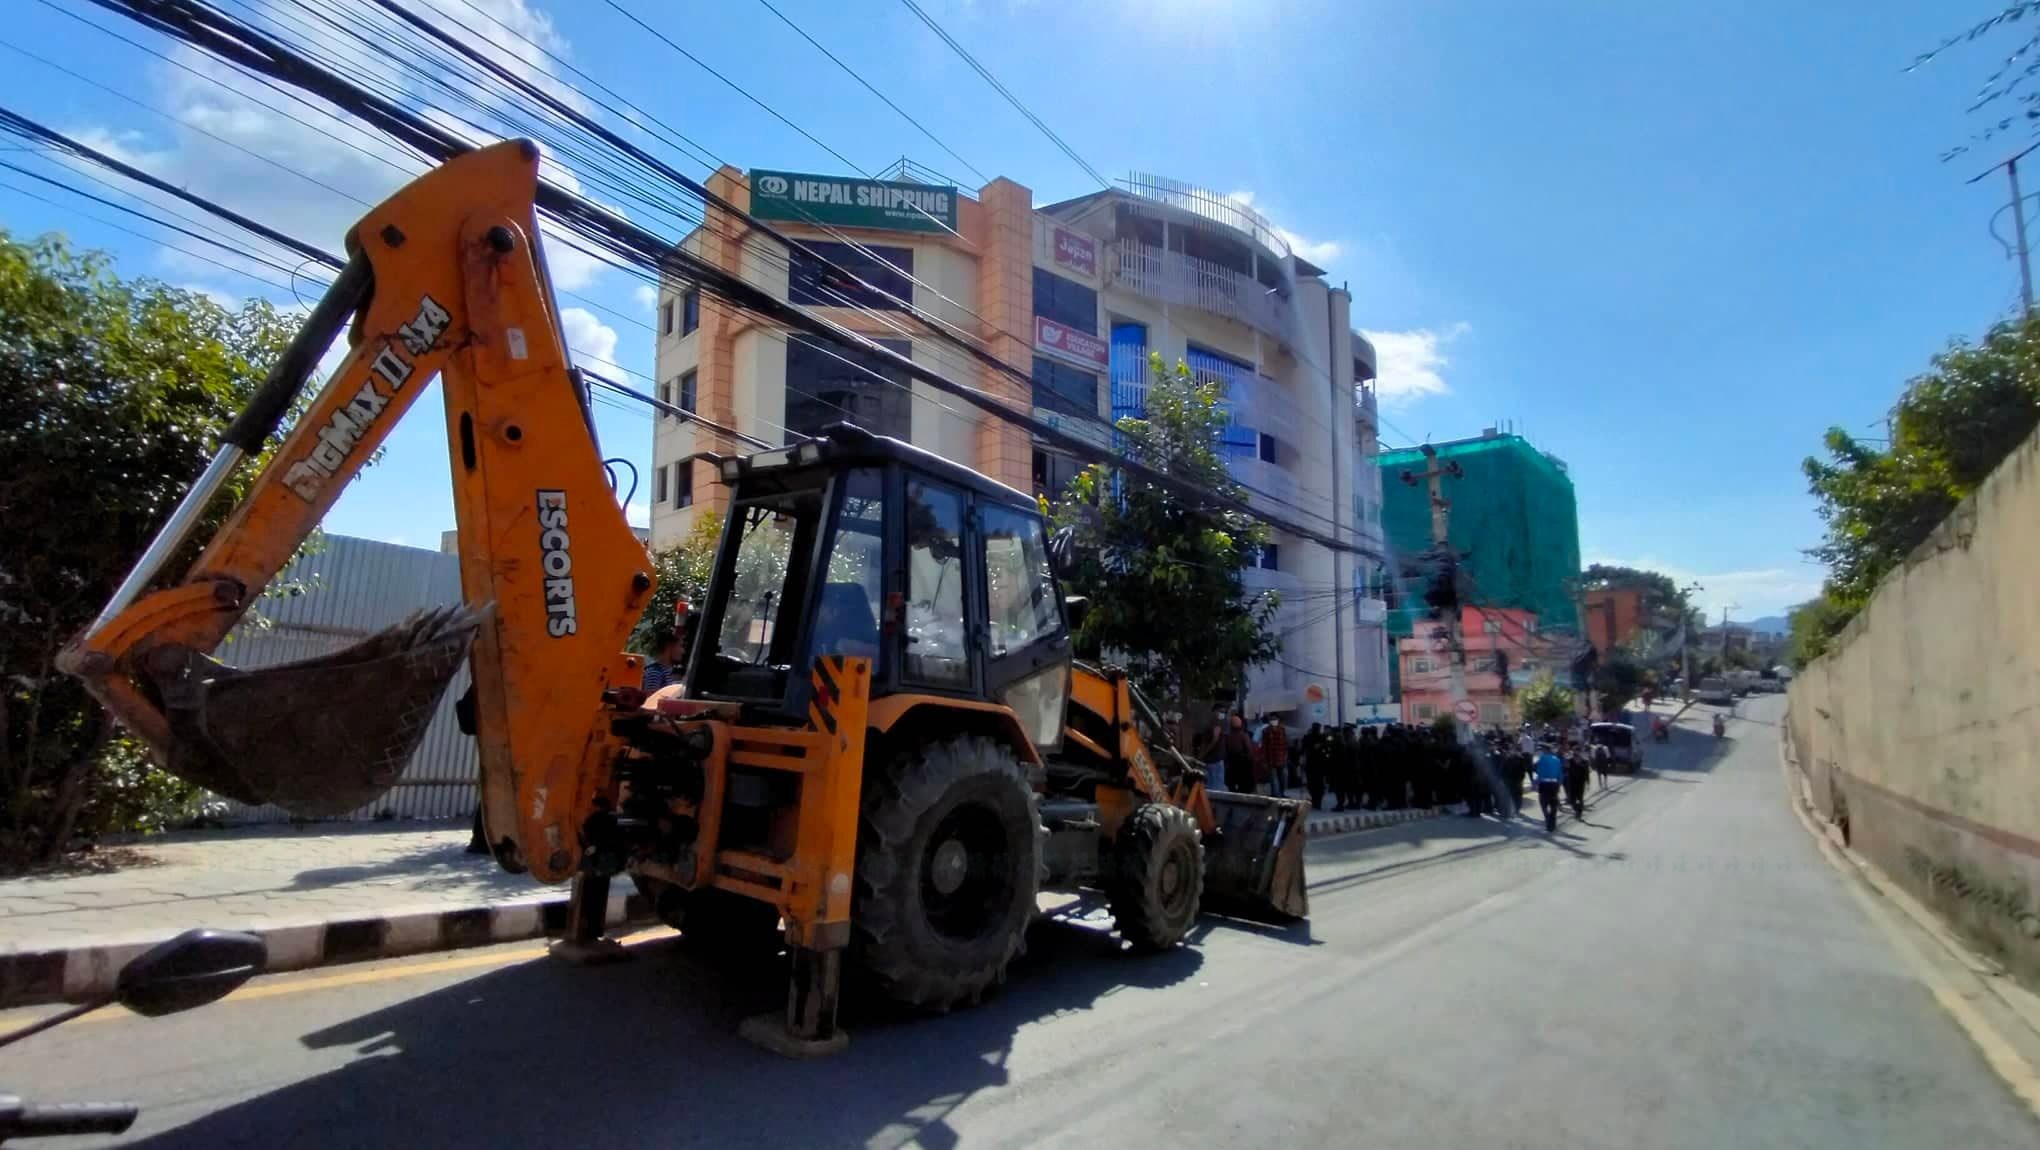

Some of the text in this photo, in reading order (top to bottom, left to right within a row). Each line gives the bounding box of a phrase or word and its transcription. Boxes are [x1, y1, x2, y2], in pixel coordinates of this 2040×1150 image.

[794, 180, 949, 213] NEPAL SHIPPING
[537, 489, 577, 638] ESCORTS
